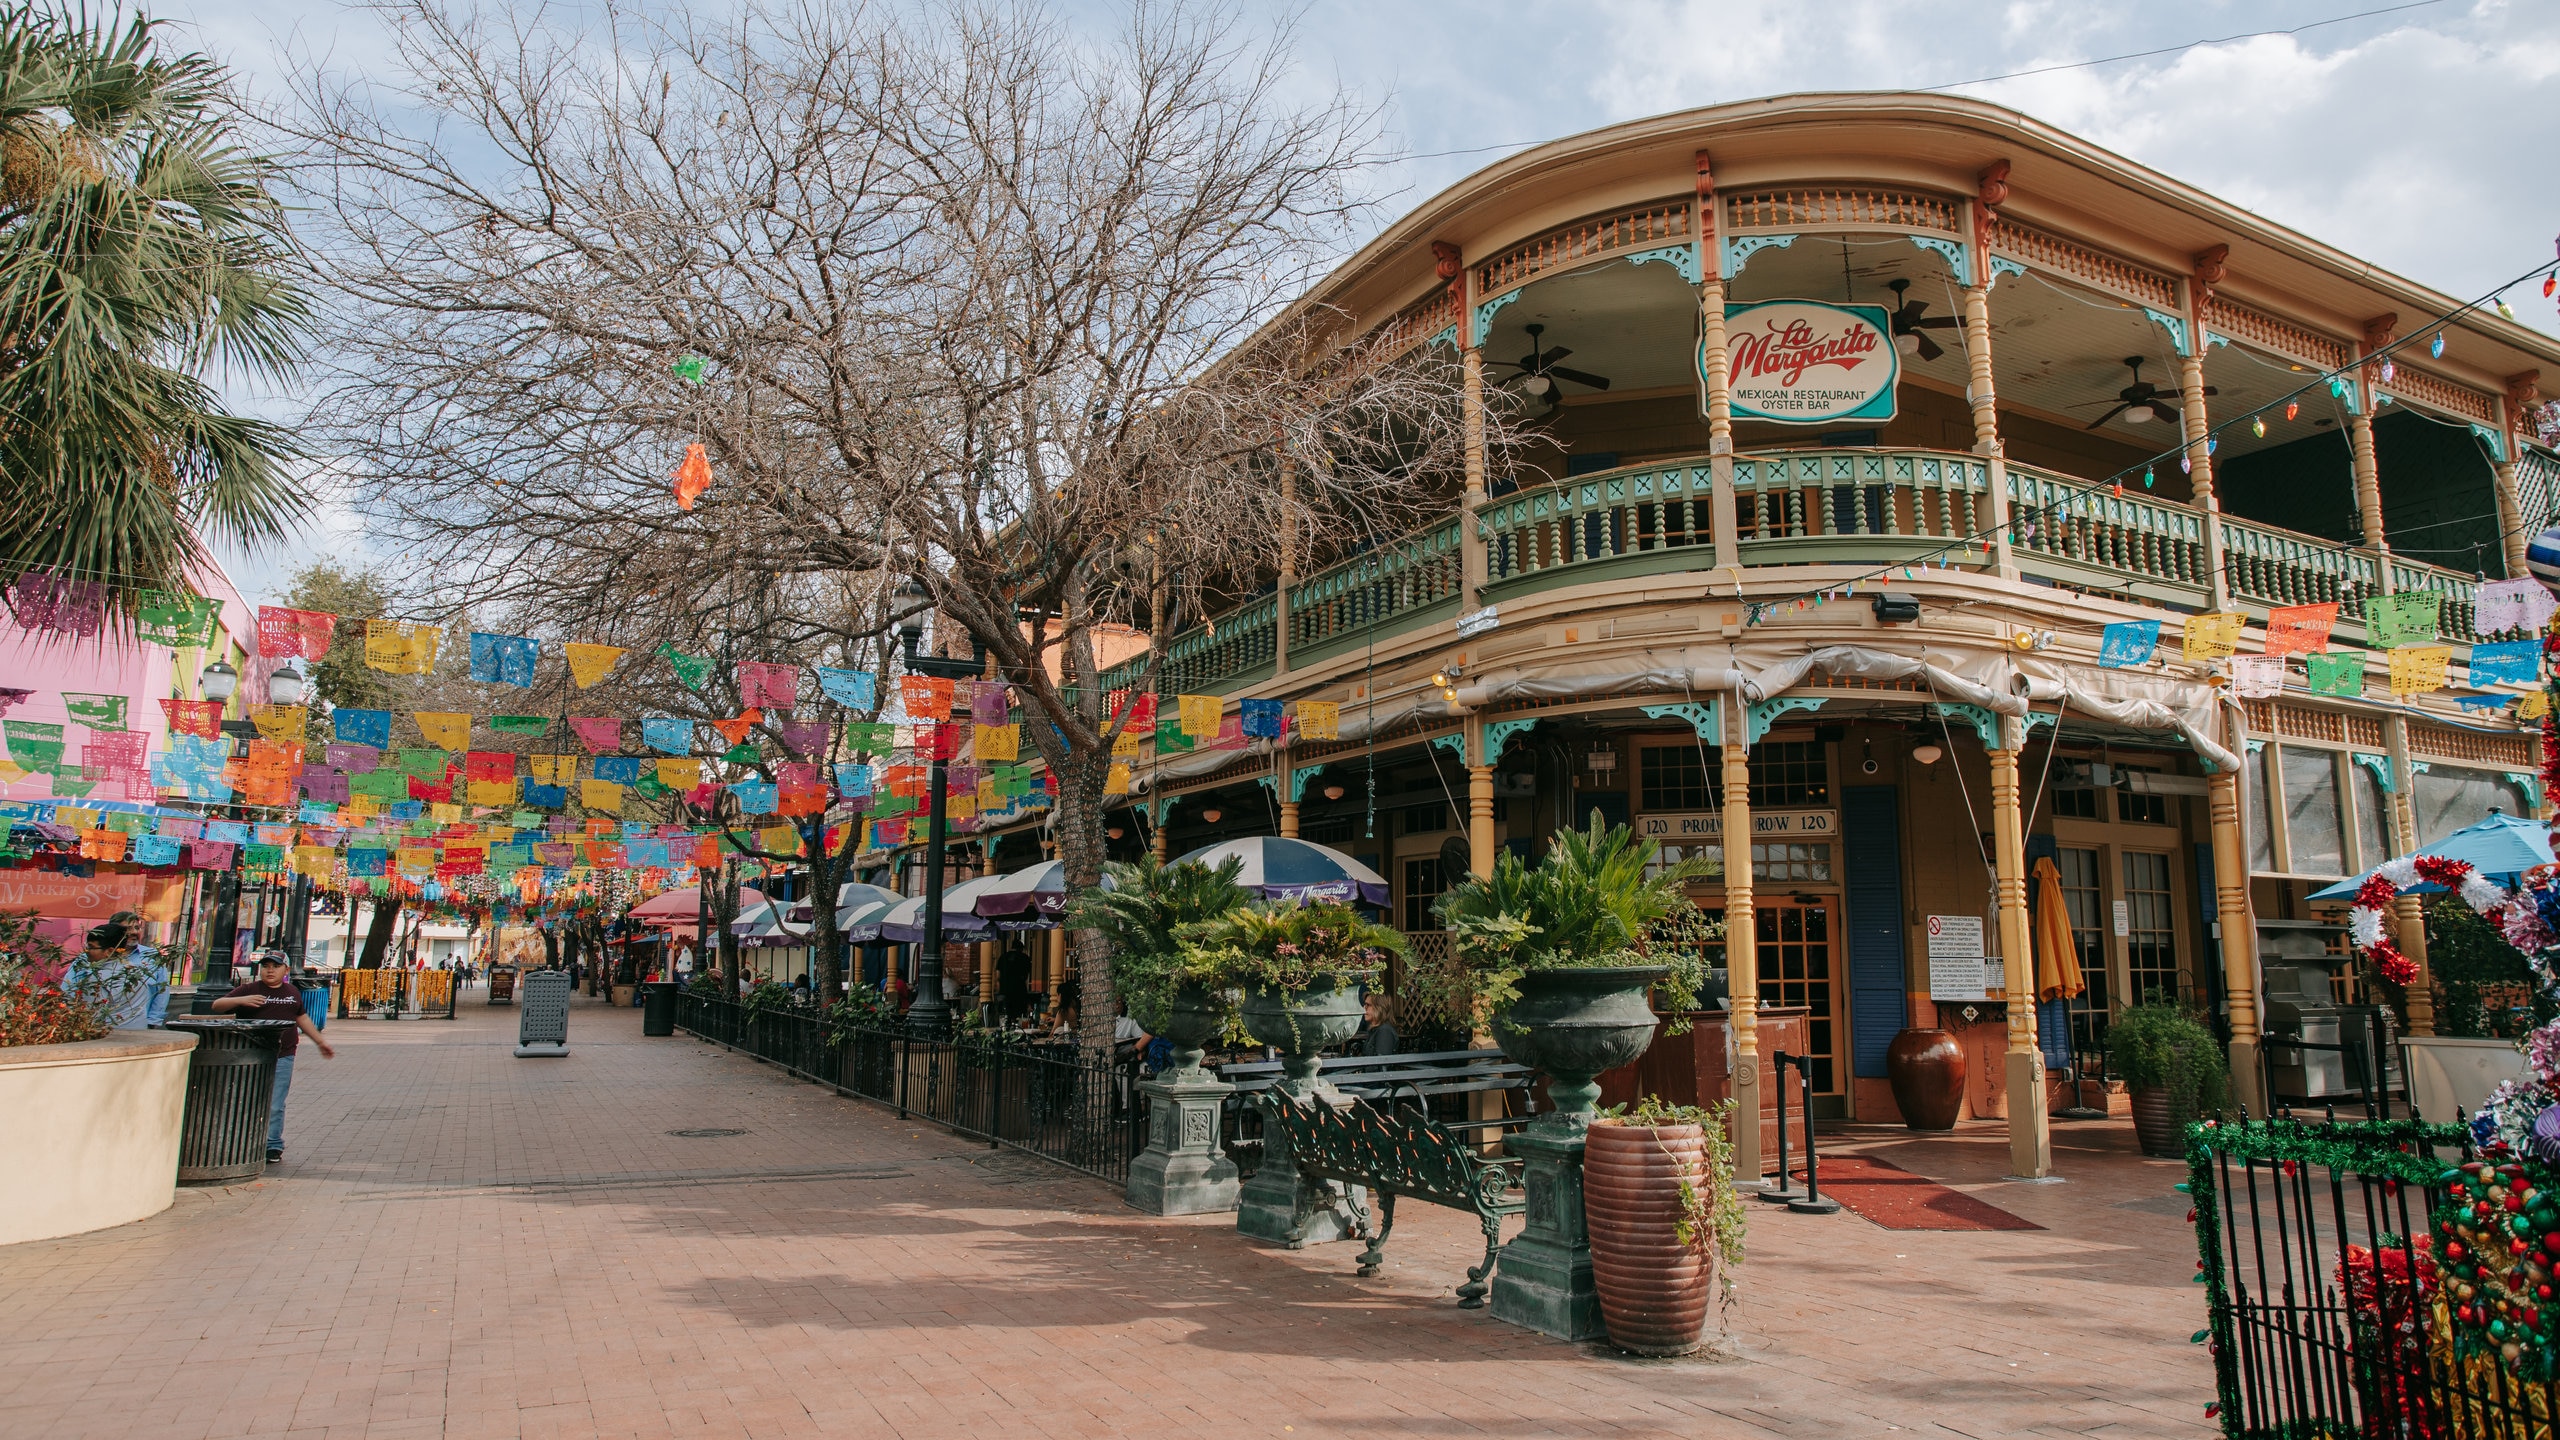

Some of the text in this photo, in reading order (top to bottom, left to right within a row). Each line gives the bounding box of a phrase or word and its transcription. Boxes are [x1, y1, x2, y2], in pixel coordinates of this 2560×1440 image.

[1767, 318, 1829, 351] La
[1728, 323, 1878, 387] Margarita
[1737, 389, 1866, 400] MEXICAN RESTAURANT
[1761, 400, 1830, 410] OYSTER BAR
[1646, 816, 1826, 834] 120 PROD ROW 120
[0, 881, 149, 909] MARKET SQUARE
[1278, 883, 1349, 901] La Margarita
[1042, 896, 1058, 908] La
